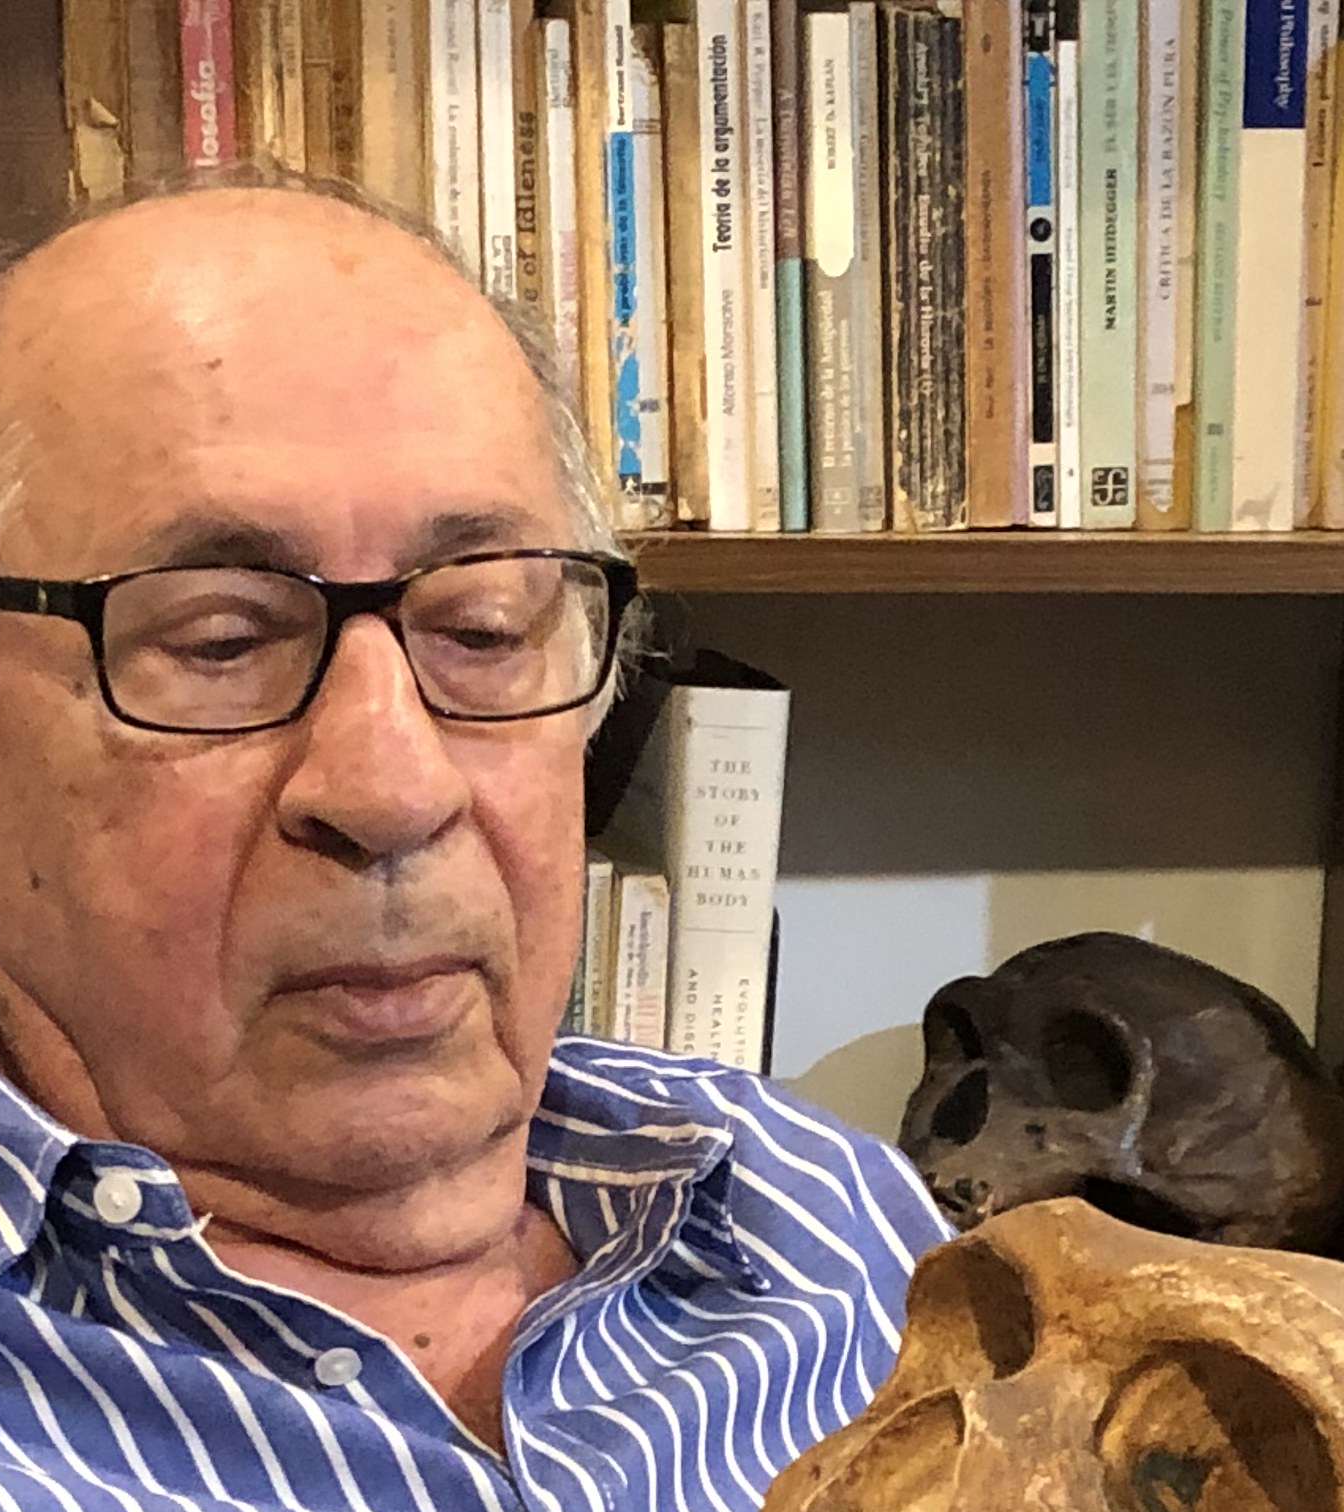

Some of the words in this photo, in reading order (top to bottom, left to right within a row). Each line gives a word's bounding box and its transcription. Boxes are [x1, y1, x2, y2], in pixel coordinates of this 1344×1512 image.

[705, 33, 734, 153] argumentación
[514, 111, 538, 235] Idleness
[710, 158, 730, 173] la
[711, 178, 730, 197] de
[1104, 168, 1117, 264] HEIDEGGER
[1104, 268, 1117, 331] MARTIN
[709, 758, 752, 775] THE
[696, 785, 762, 802] STORY
[713, 812, 742, 829] OF
[703, 839, 747, 856] THE
[686, 864, 761, 882] HUMAN
[695, 891, 750, 908] BODY
[686, 968, 699, 1005] AND
